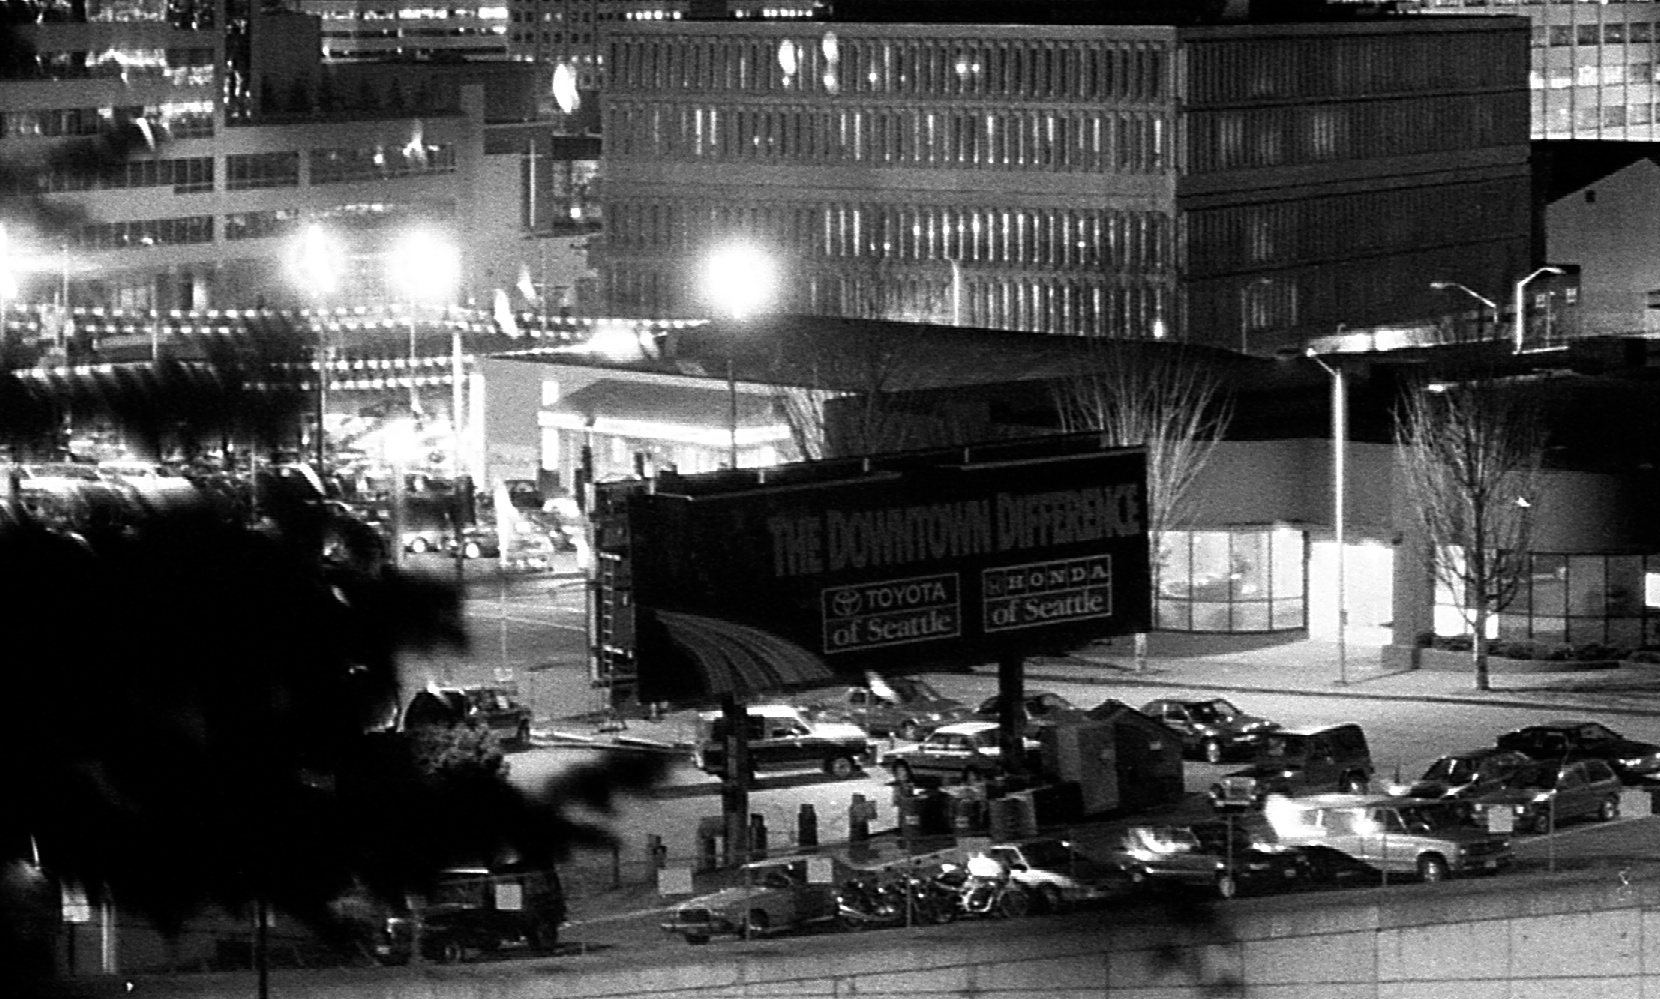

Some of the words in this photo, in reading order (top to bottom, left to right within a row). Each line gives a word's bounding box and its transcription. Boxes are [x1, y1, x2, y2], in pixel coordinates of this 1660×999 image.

[768, 514, 822, 576] THE
[828, 500, 991, 572] DOWNTOWN
[998, 483, 1140, 551] DIFFERENCE
[866, 581, 947, 608] TOYOTA
[1007, 565, 1109, 592] HONDA
[833, 620, 862, 646] of
[868, 610, 951, 641] Seattle
[992, 603, 1021, 628] of
[1024, 592, 1102, 621] Seattle
